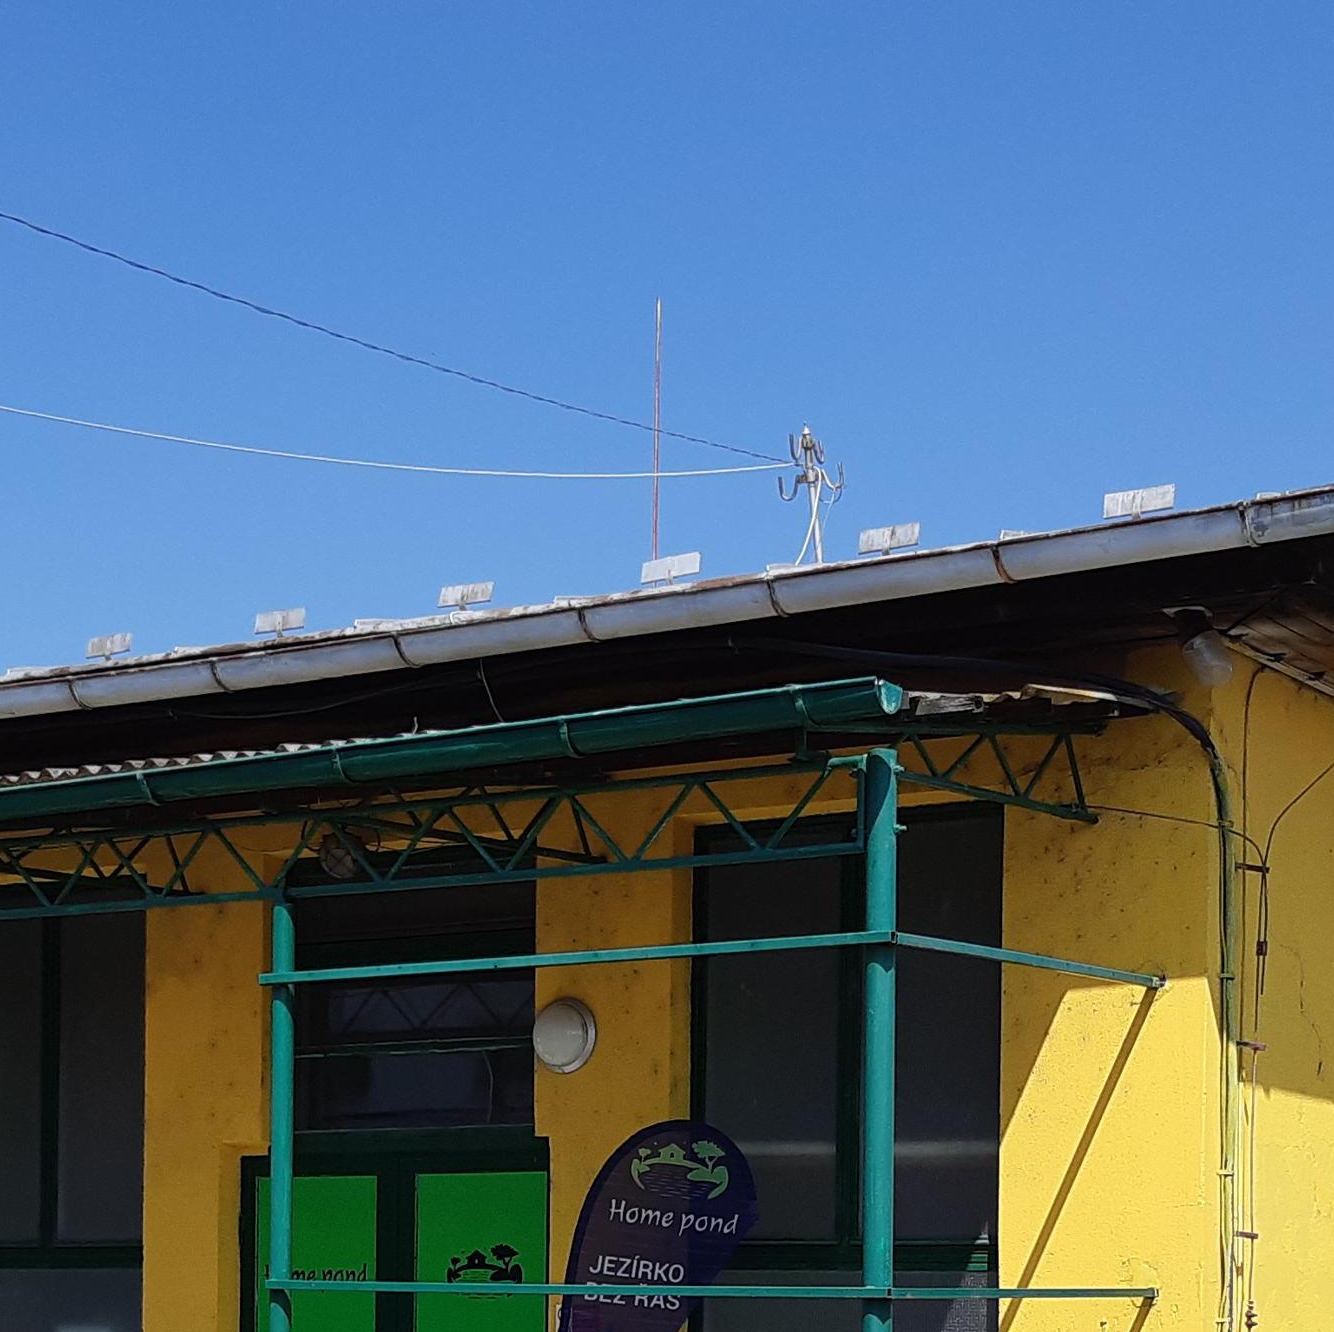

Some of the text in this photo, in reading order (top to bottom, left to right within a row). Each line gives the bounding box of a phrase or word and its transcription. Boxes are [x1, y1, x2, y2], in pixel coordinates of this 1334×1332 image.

[609, 1199, 739, 1237] Home pond
[589, 1255, 685, 1284] JEZÍRKO
